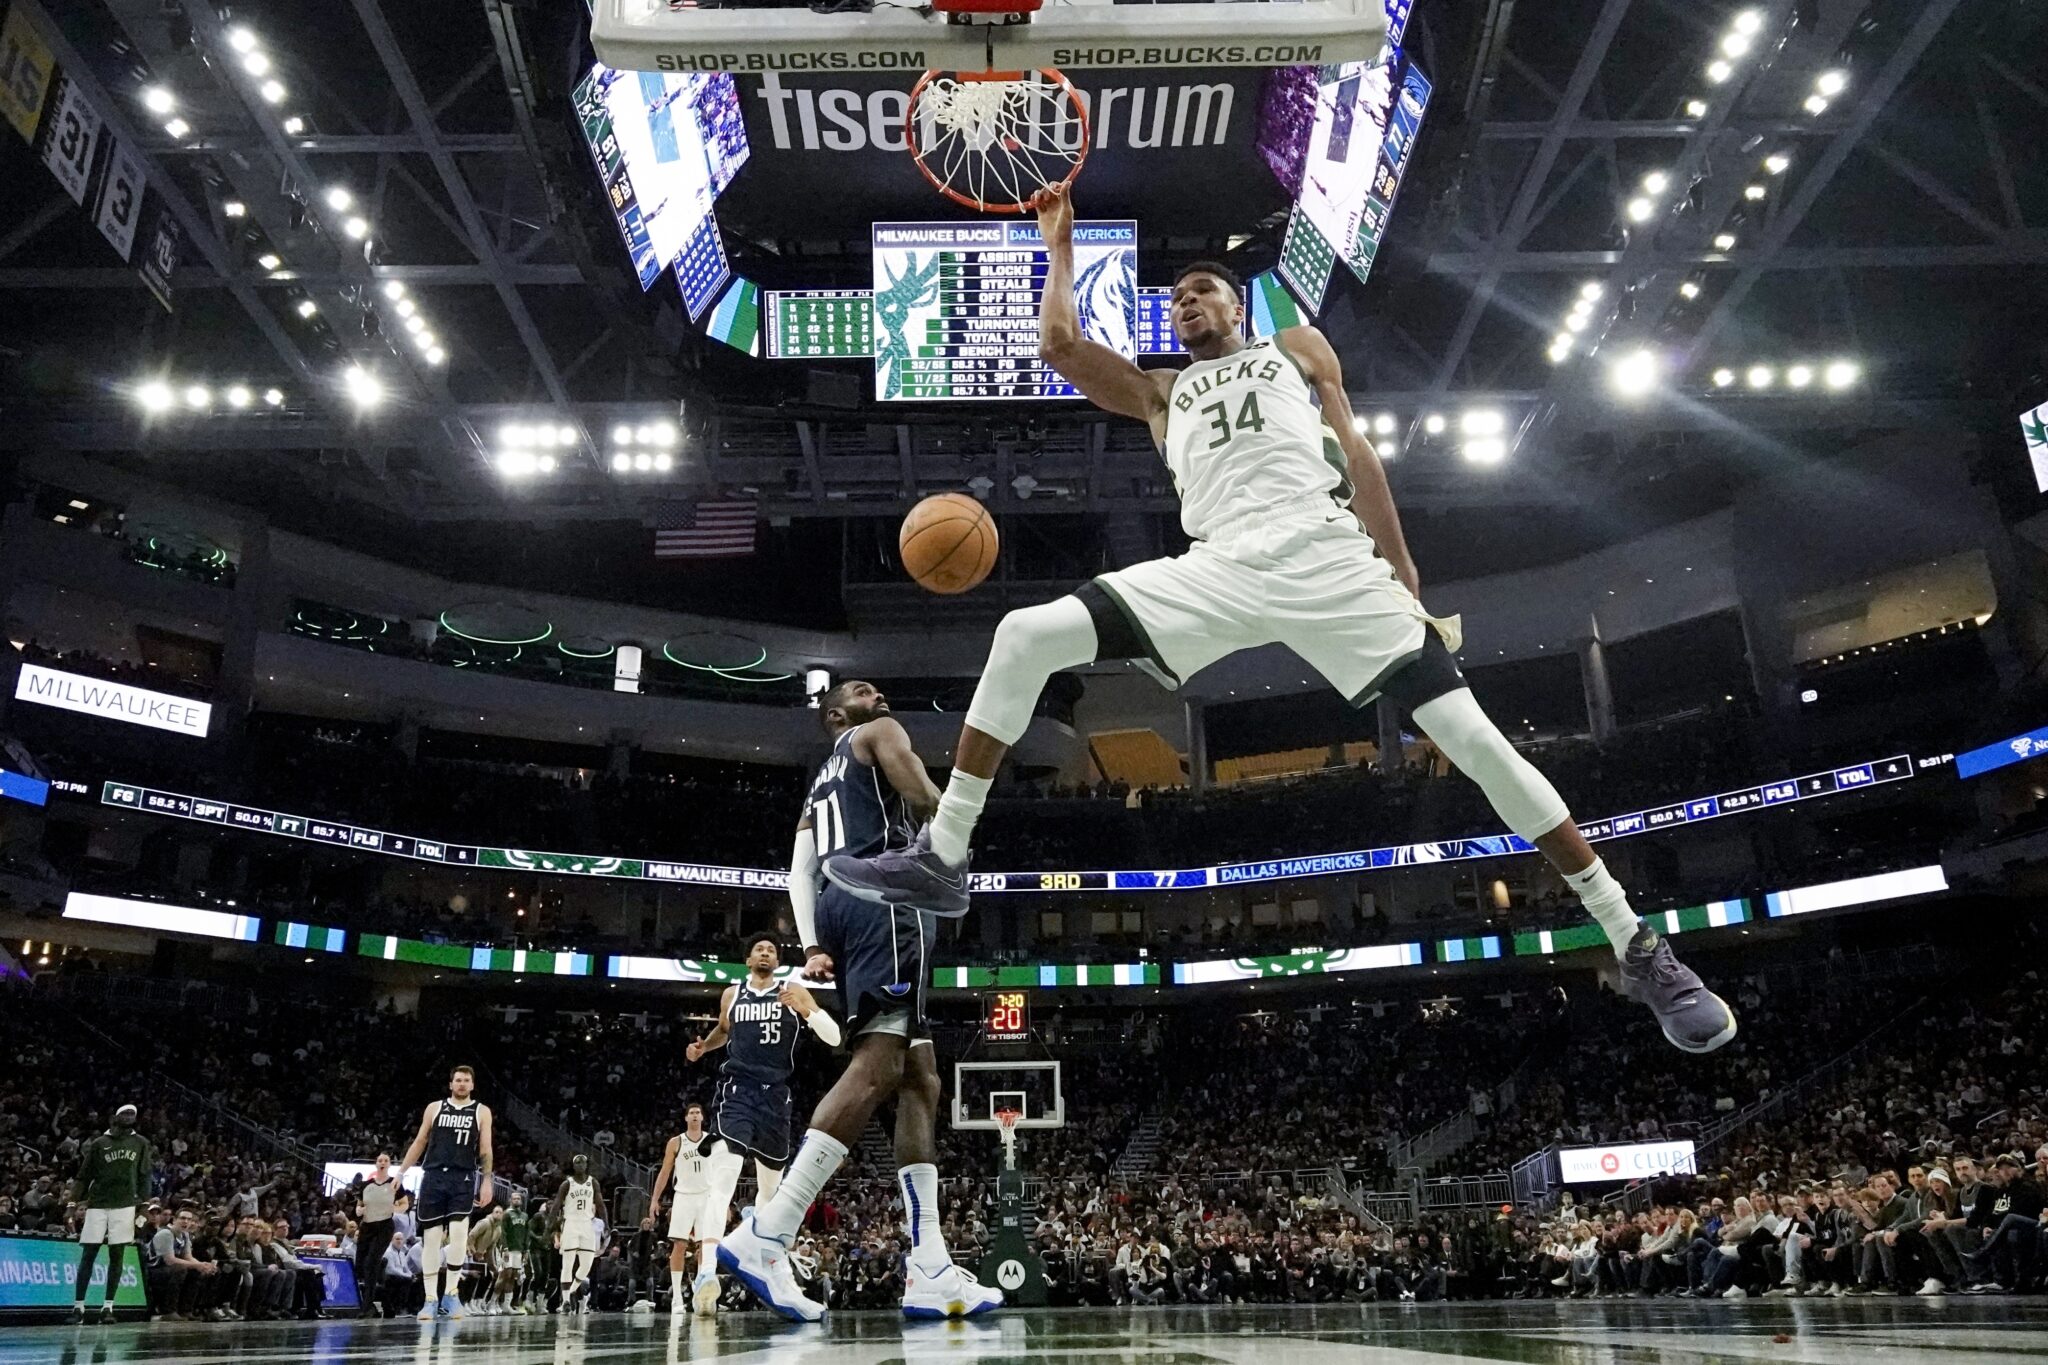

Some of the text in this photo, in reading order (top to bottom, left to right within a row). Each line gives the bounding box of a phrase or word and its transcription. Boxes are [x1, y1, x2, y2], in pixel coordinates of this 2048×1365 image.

[655, 51, 926, 71] SHOP.BUCKS.COM
[1053, 45, 1323, 65] SHOP.BUCKS.COM
[59, 110, 90, 177] 31
[1388, 122, 1404, 152] 77
[111, 177, 133, 226] 3
[1364, 206, 1378, 230] 81
[876, 229, 1001, 242] MILWAUKEE BUCKS
[1009, 228, 1133, 241] DALL AVERICKS
[978, 252, 1033, 263] ASSISTS
[979, 265, 1032, 276] BLOCKS
[980, 279, 1031, 289] STEALS
[978, 292, 1004, 303] OFF
[1006, 292, 1034, 303] REB
[809, 304, 816, 312] 7
[826, 303, 834, 312] 0
[861, 303, 868, 311] 0
[978, 306, 1004, 316] DEF
[1006, 305, 1034, 316] REB
[1140, 300, 1172, 309] 10 10
[789, 314, 797, 323] 11
[827, 313, 834, 322] 3
[846, 313, 851, 322] 1
[1141, 311, 1169, 320] 11 3
[788, 324, 868, 333] 12 22 2 2 2
[1159, 321, 1171, 331] 12
[788, 336, 799, 344] 21
[809, 335, 818, 343] 11
[828, 335, 833, 343] 1
[861, 334, 869, 343] 0
[963, 332, 1005, 343] TOTAL
[1007, 332, 1040, 343] FOUL
[1139, 332, 1153, 341] 35
[787, 346, 800, 355] 34
[807, 346, 821, 354] 20
[846, 346, 851, 354] 1
[862, 346, 869, 354] 3
[958, 346, 1004, 356] BENCH
[1006, 346, 1038, 356] POIN
[1140, 343, 1152, 352] 77
[998, 359, 1016, 370] FG
[951, 373, 975, 383] 50.0
[994, 372, 1020, 383] 3PT
[998, 385, 1015, 396] FT
[1174, 359, 1283, 413] BUCKS
[1201, 391, 1266, 450] 34
[28, 674, 200, 728] MILWAUKEE
[1615, 816, 1641, 832] 3PT
[1650, 810, 1674, 825] 50.0
[1692, 802, 1711, 816] FT
[1766, 783, 1795, 801] FLS
[1811, 779, 1821, 790] 2
[1838, 769, 1871, 786] TOL
[1887, 763, 1898, 774] 4
[112, 788, 135, 803] FG
[195, 803, 226, 819] 3PT
[235, 811, 261, 825] 50.0
[281, 818, 300, 832] FT
[353, 832, 379, 847] FLS
[418, 843, 443, 858] TOL
[812, 789, 846, 857] 11
[648, 863, 741, 885] MILWAUKEE
[1221, 856, 1366, 882] DALLAS MAVERICKS
[1040, 874, 1081, 890] 3RD
[1153, 871, 1178, 888] 77
[997, 993, 1024, 1008] 7:20
[734, 1001, 782, 1024] MAVS
[993, 1008, 1021, 1030] 20
[760, 1021, 782, 1045] 35
[438, 1113, 474, 1129] MAVS
[454, 1128, 471, 1146] 77
[104, 1149, 137, 1163] BUCKS
[682, 1148, 699, 1160] BUC
[1633, 1150, 1685, 1170] CLUB
[693, 1160, 701, 1173] 11
[570, 1187, 592, 1199] BUCKS
[576, 1199, 586, 1210] 21
